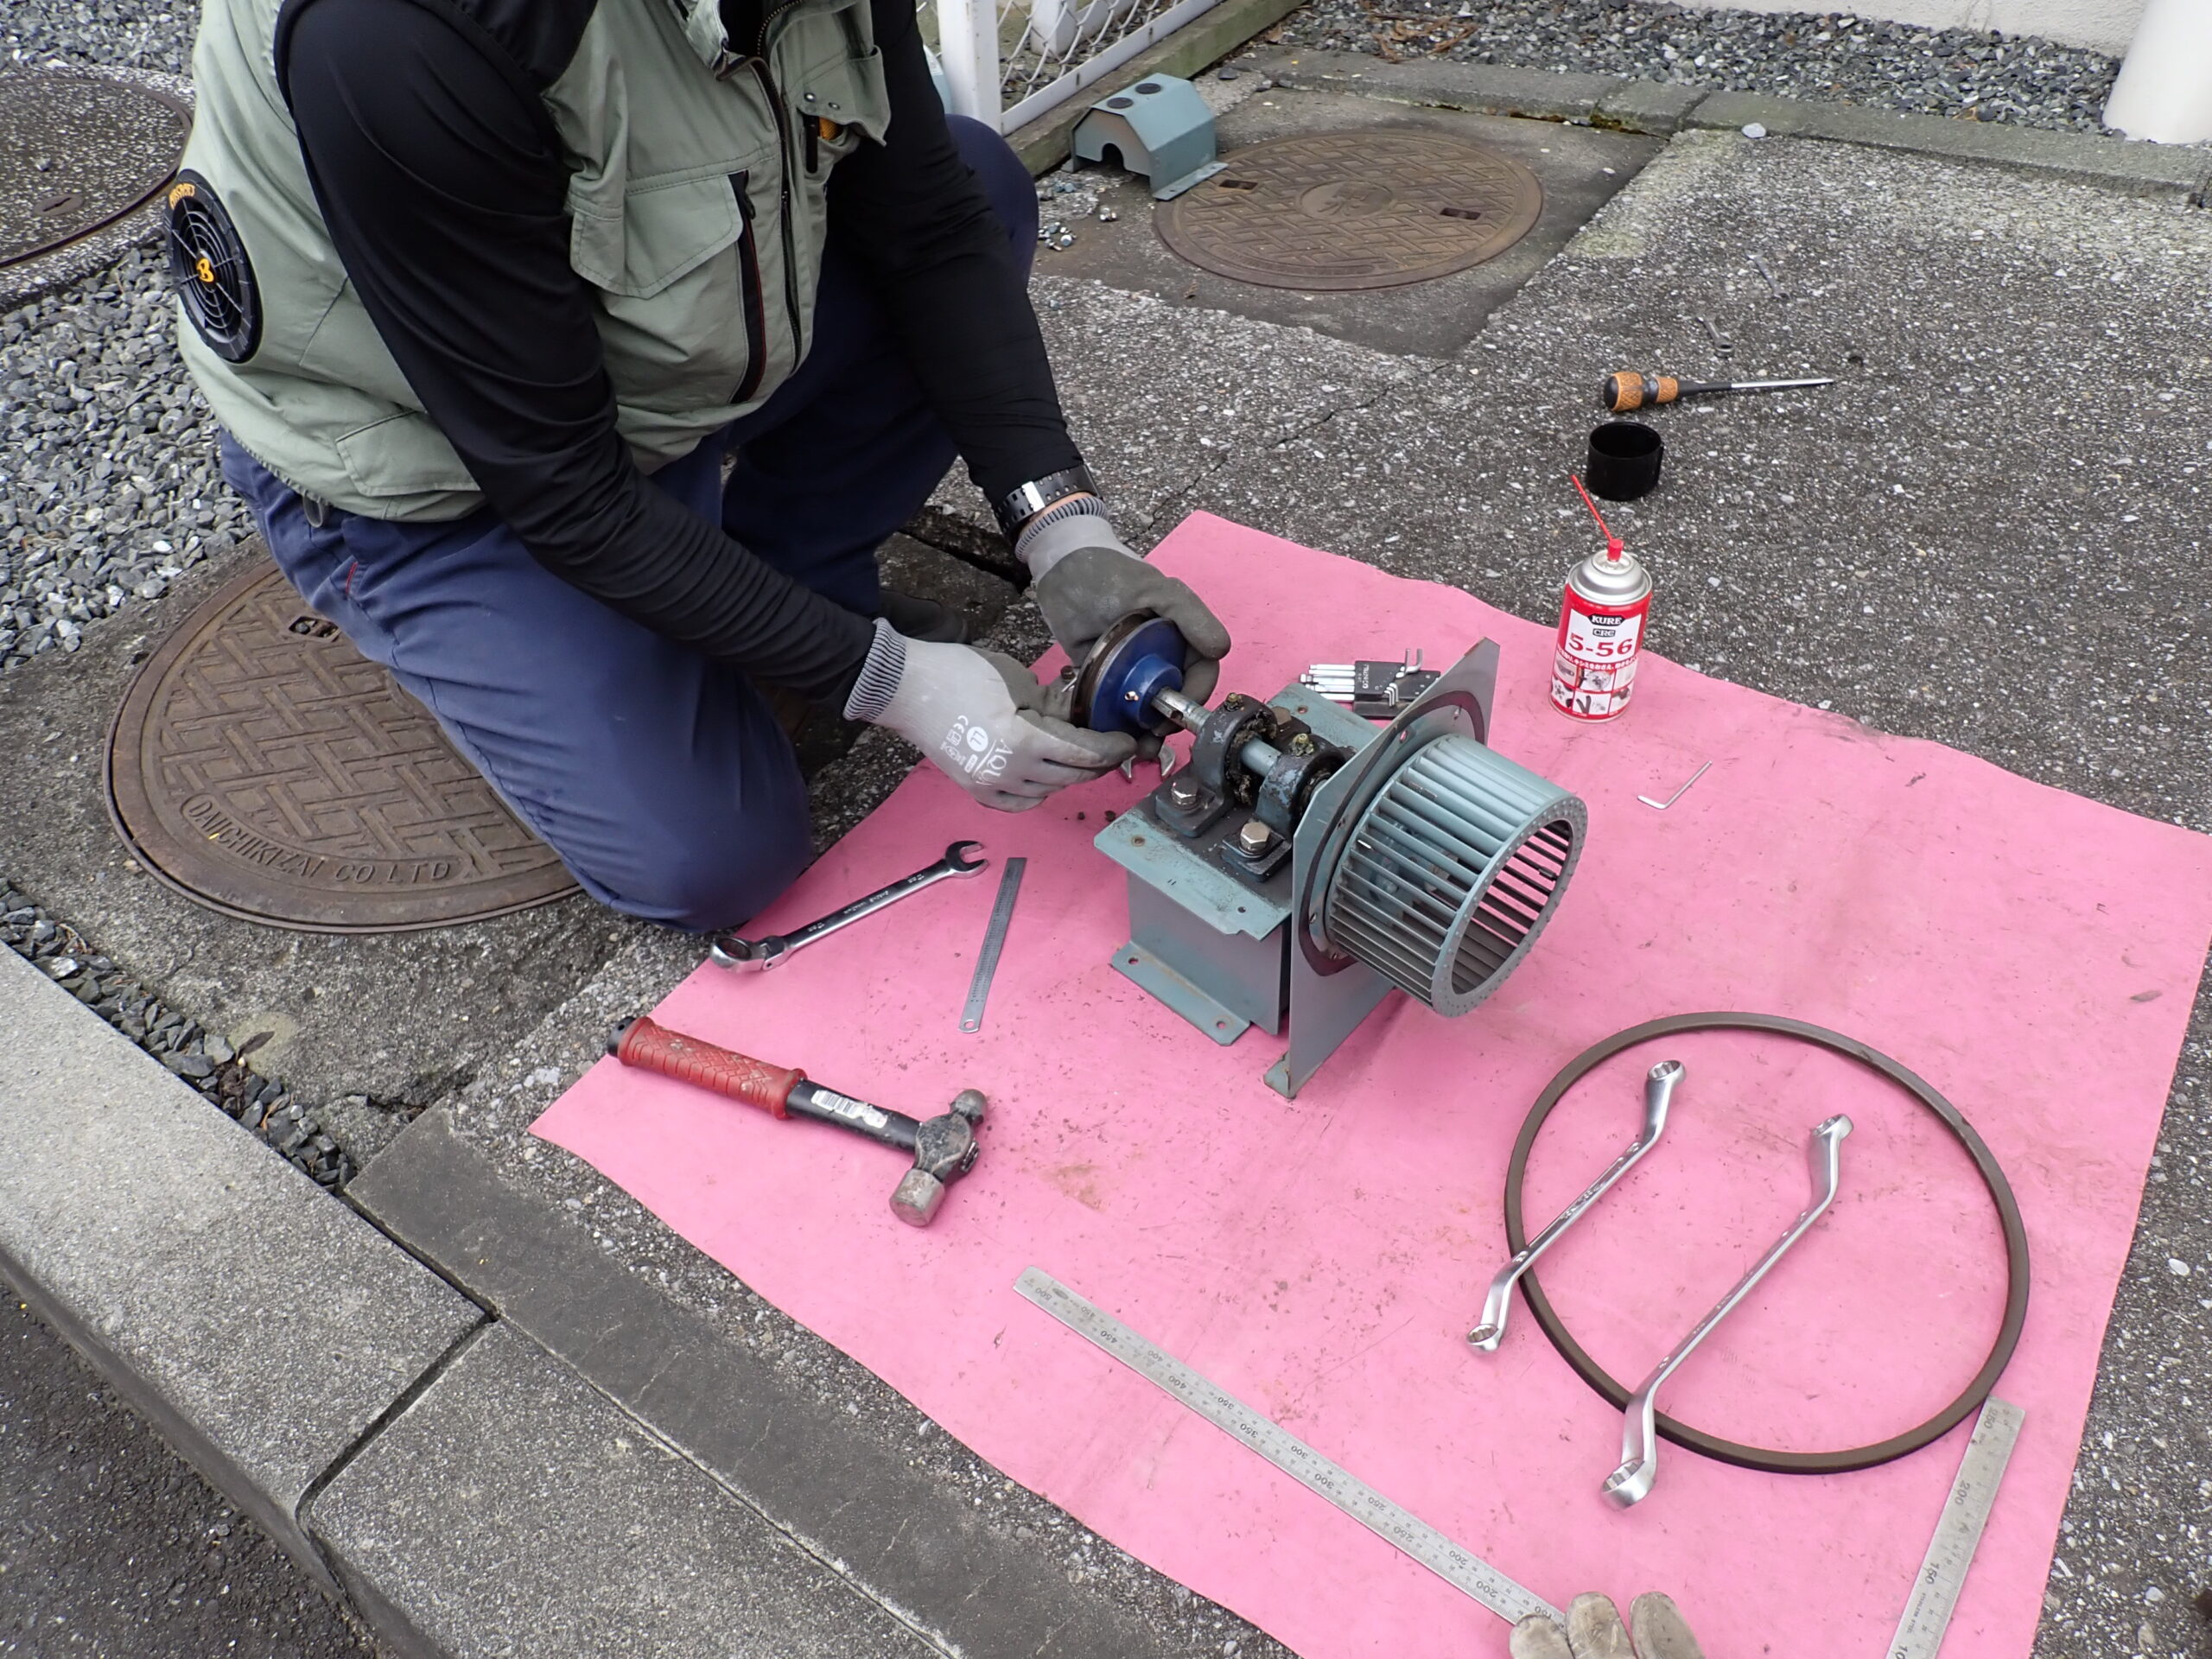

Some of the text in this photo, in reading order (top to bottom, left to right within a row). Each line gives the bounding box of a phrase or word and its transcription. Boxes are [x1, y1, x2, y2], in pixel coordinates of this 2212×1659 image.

[1591, 614, 1622, 626] KURE
[1568, 632, 1633, 657] 5-56
[976, 738, 1014, 785] AQUA
[1168, 1375, 1187, 1389] 400
[1240, 1423, 1259, 1439] 350
[1291, 1445, 1309, 1459] 300
[1314, 1473, 1335, 1490] 300
[1955, 1480, 1970, 1506] 200
[1448, 1550, 1469, 1566] 200
[1925, 1562, 1940, 1585] 150
[1476, 1580, 1498, 1598] 200
